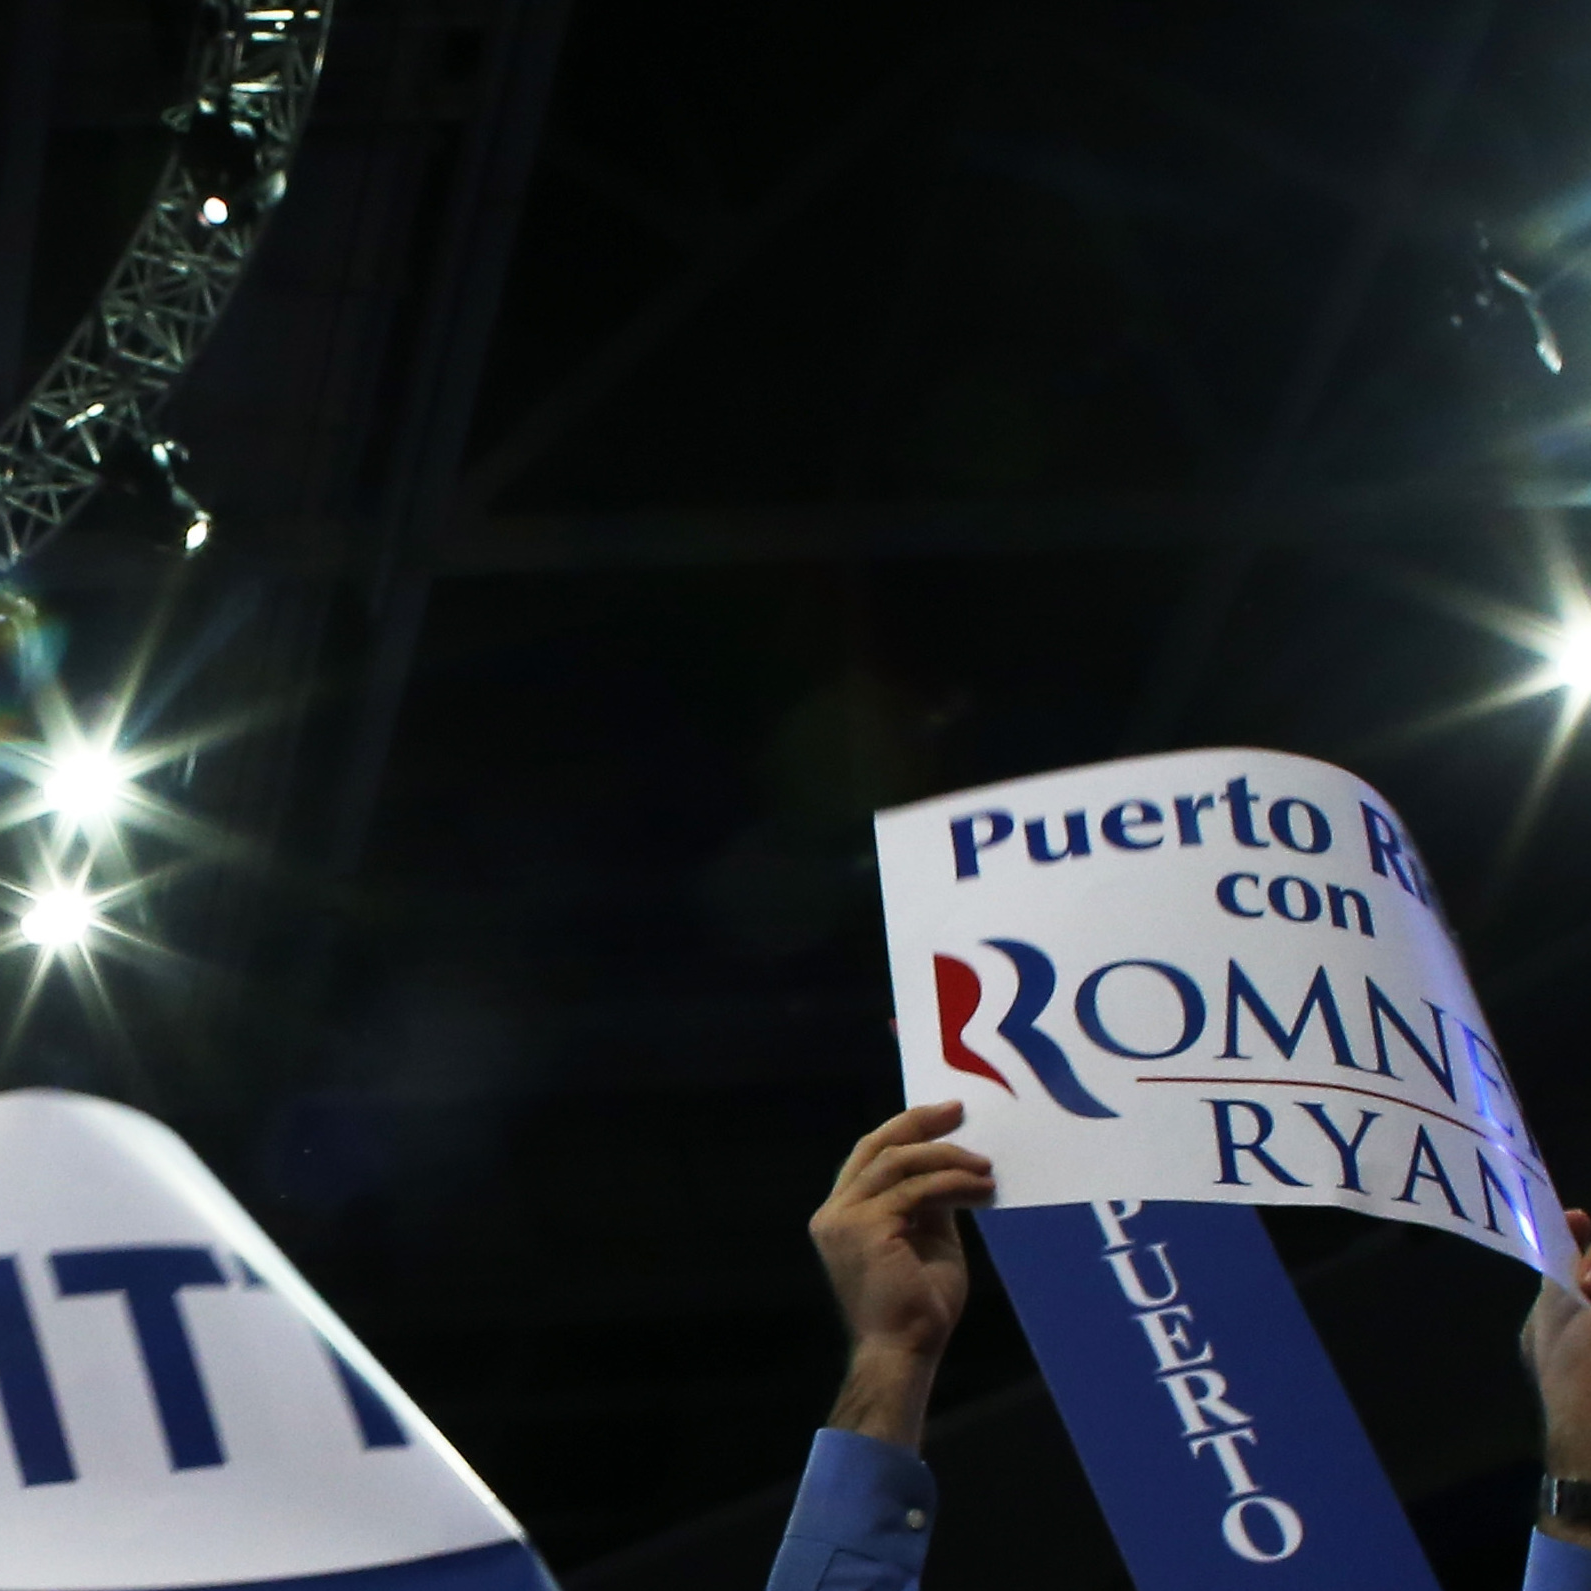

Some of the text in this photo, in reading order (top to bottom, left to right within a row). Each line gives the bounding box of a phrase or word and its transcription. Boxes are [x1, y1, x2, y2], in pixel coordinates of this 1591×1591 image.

[949, 775, 1332, 881] Puerto
[1215, 870, 1376, 938] con
[933, 938, 1545, 1160] ROMNE
[1200, 1098, 1543, 1255] RYAN
[1091, 1200, 1304, 1563] PUERTO
